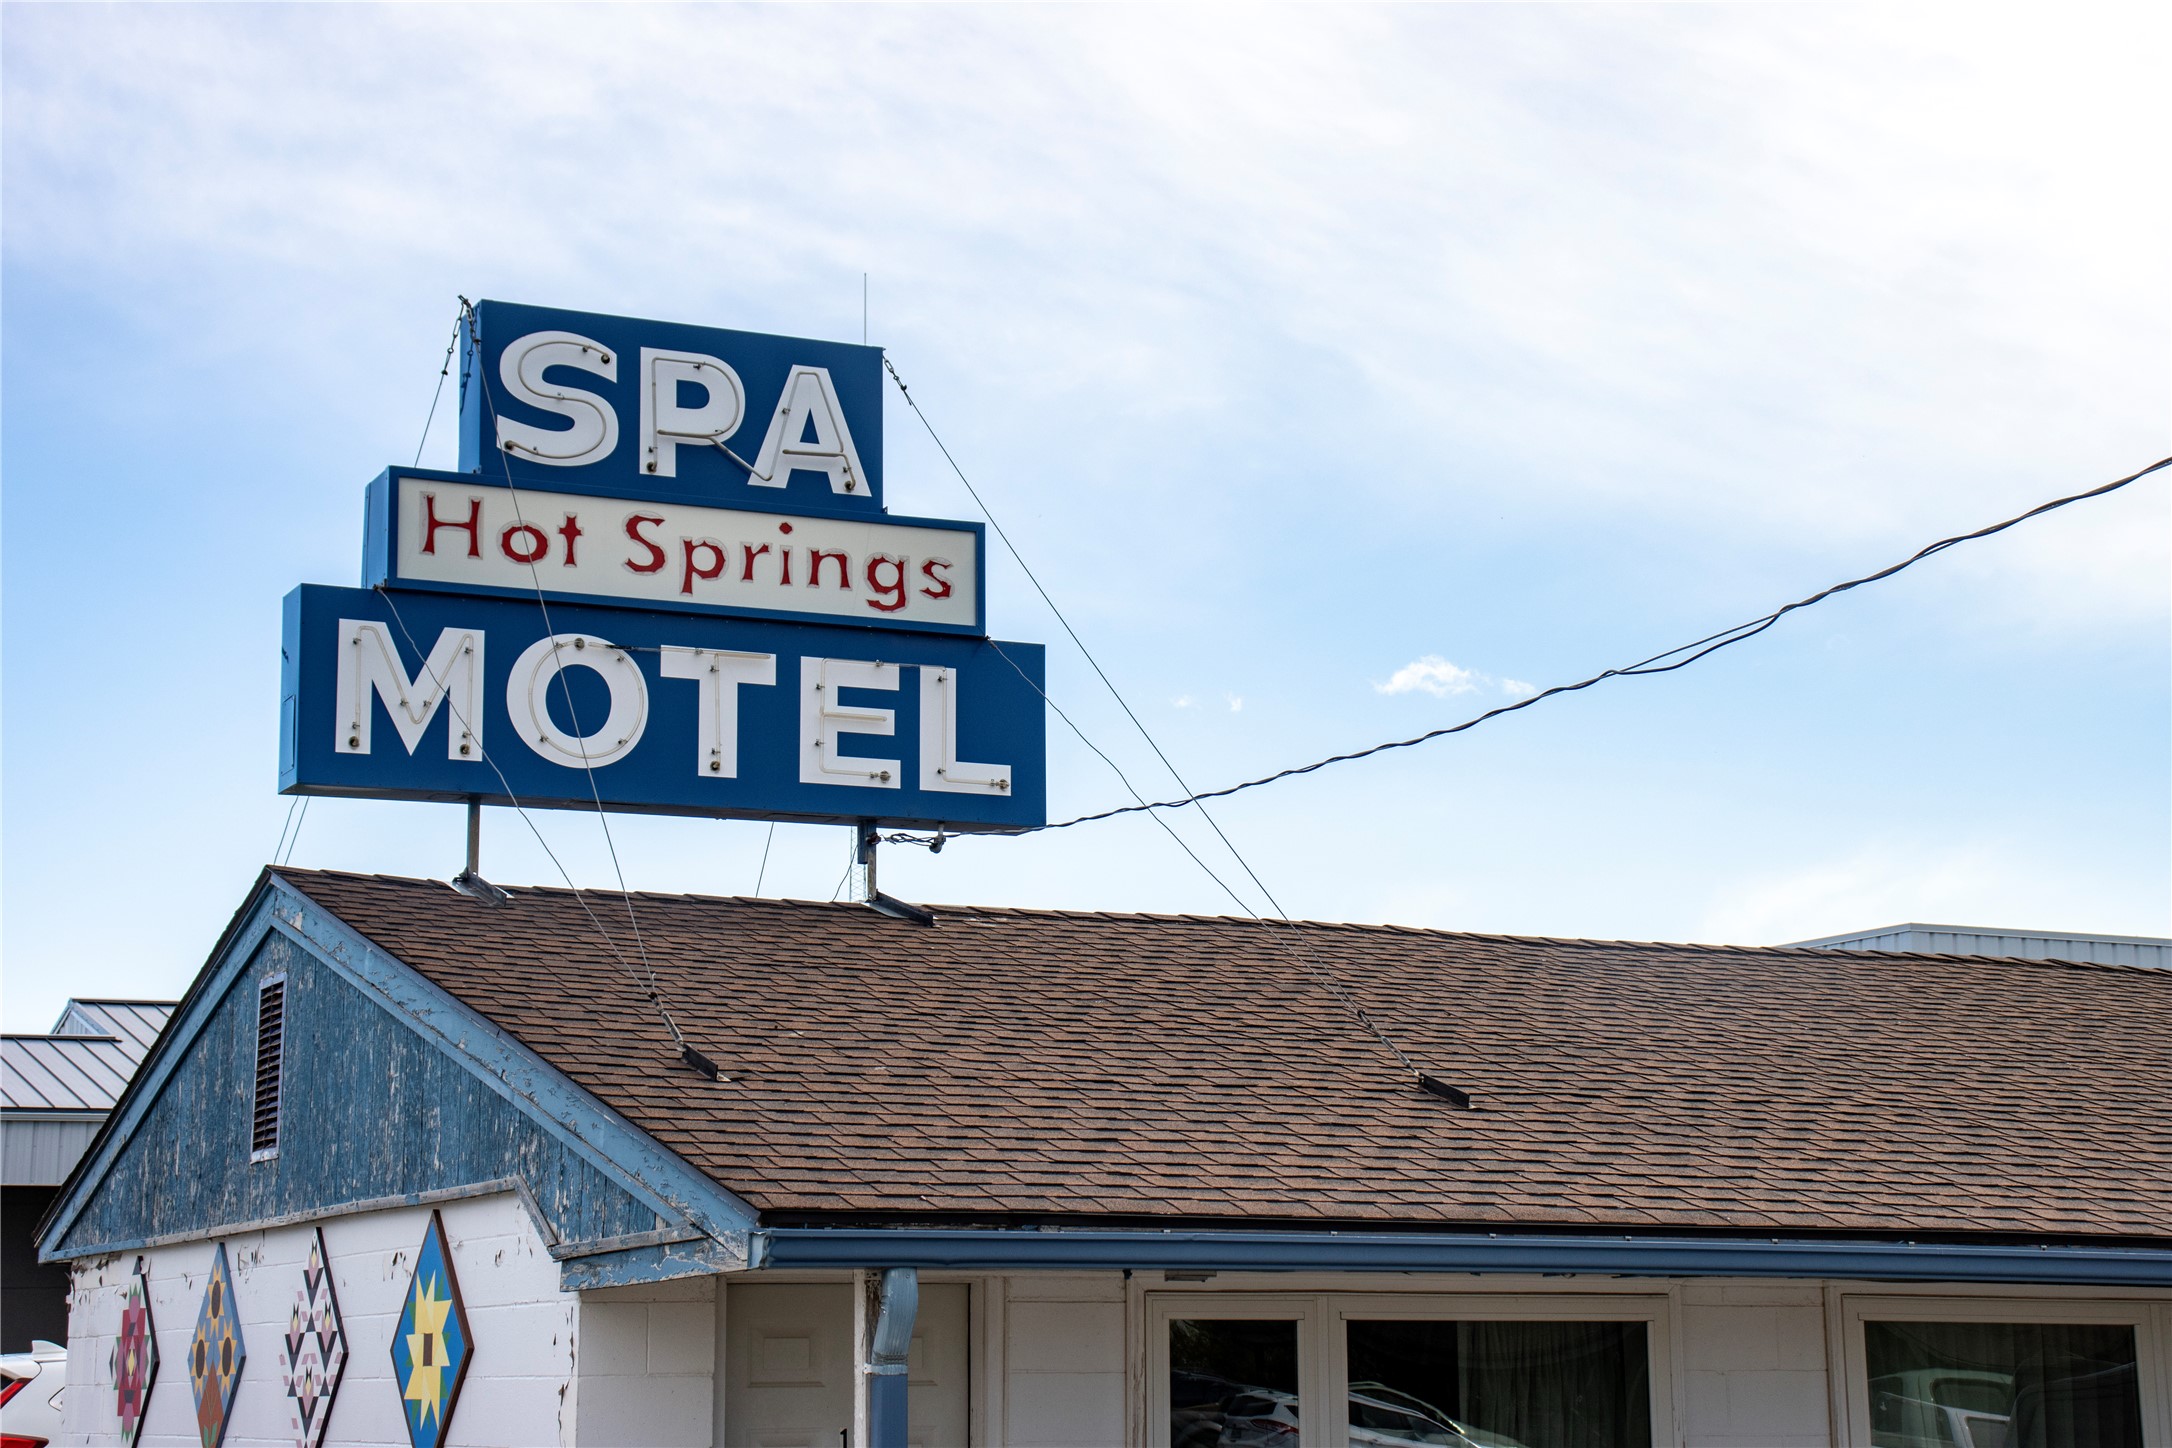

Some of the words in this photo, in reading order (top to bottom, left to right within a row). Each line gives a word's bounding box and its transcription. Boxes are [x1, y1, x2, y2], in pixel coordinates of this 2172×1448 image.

[496, 330, 872, 498] SPA
[420, 493, 584, 567] Hot
[623, 510, 955, 612] Springs
[335, 618, 1011, 796] MOTEL
